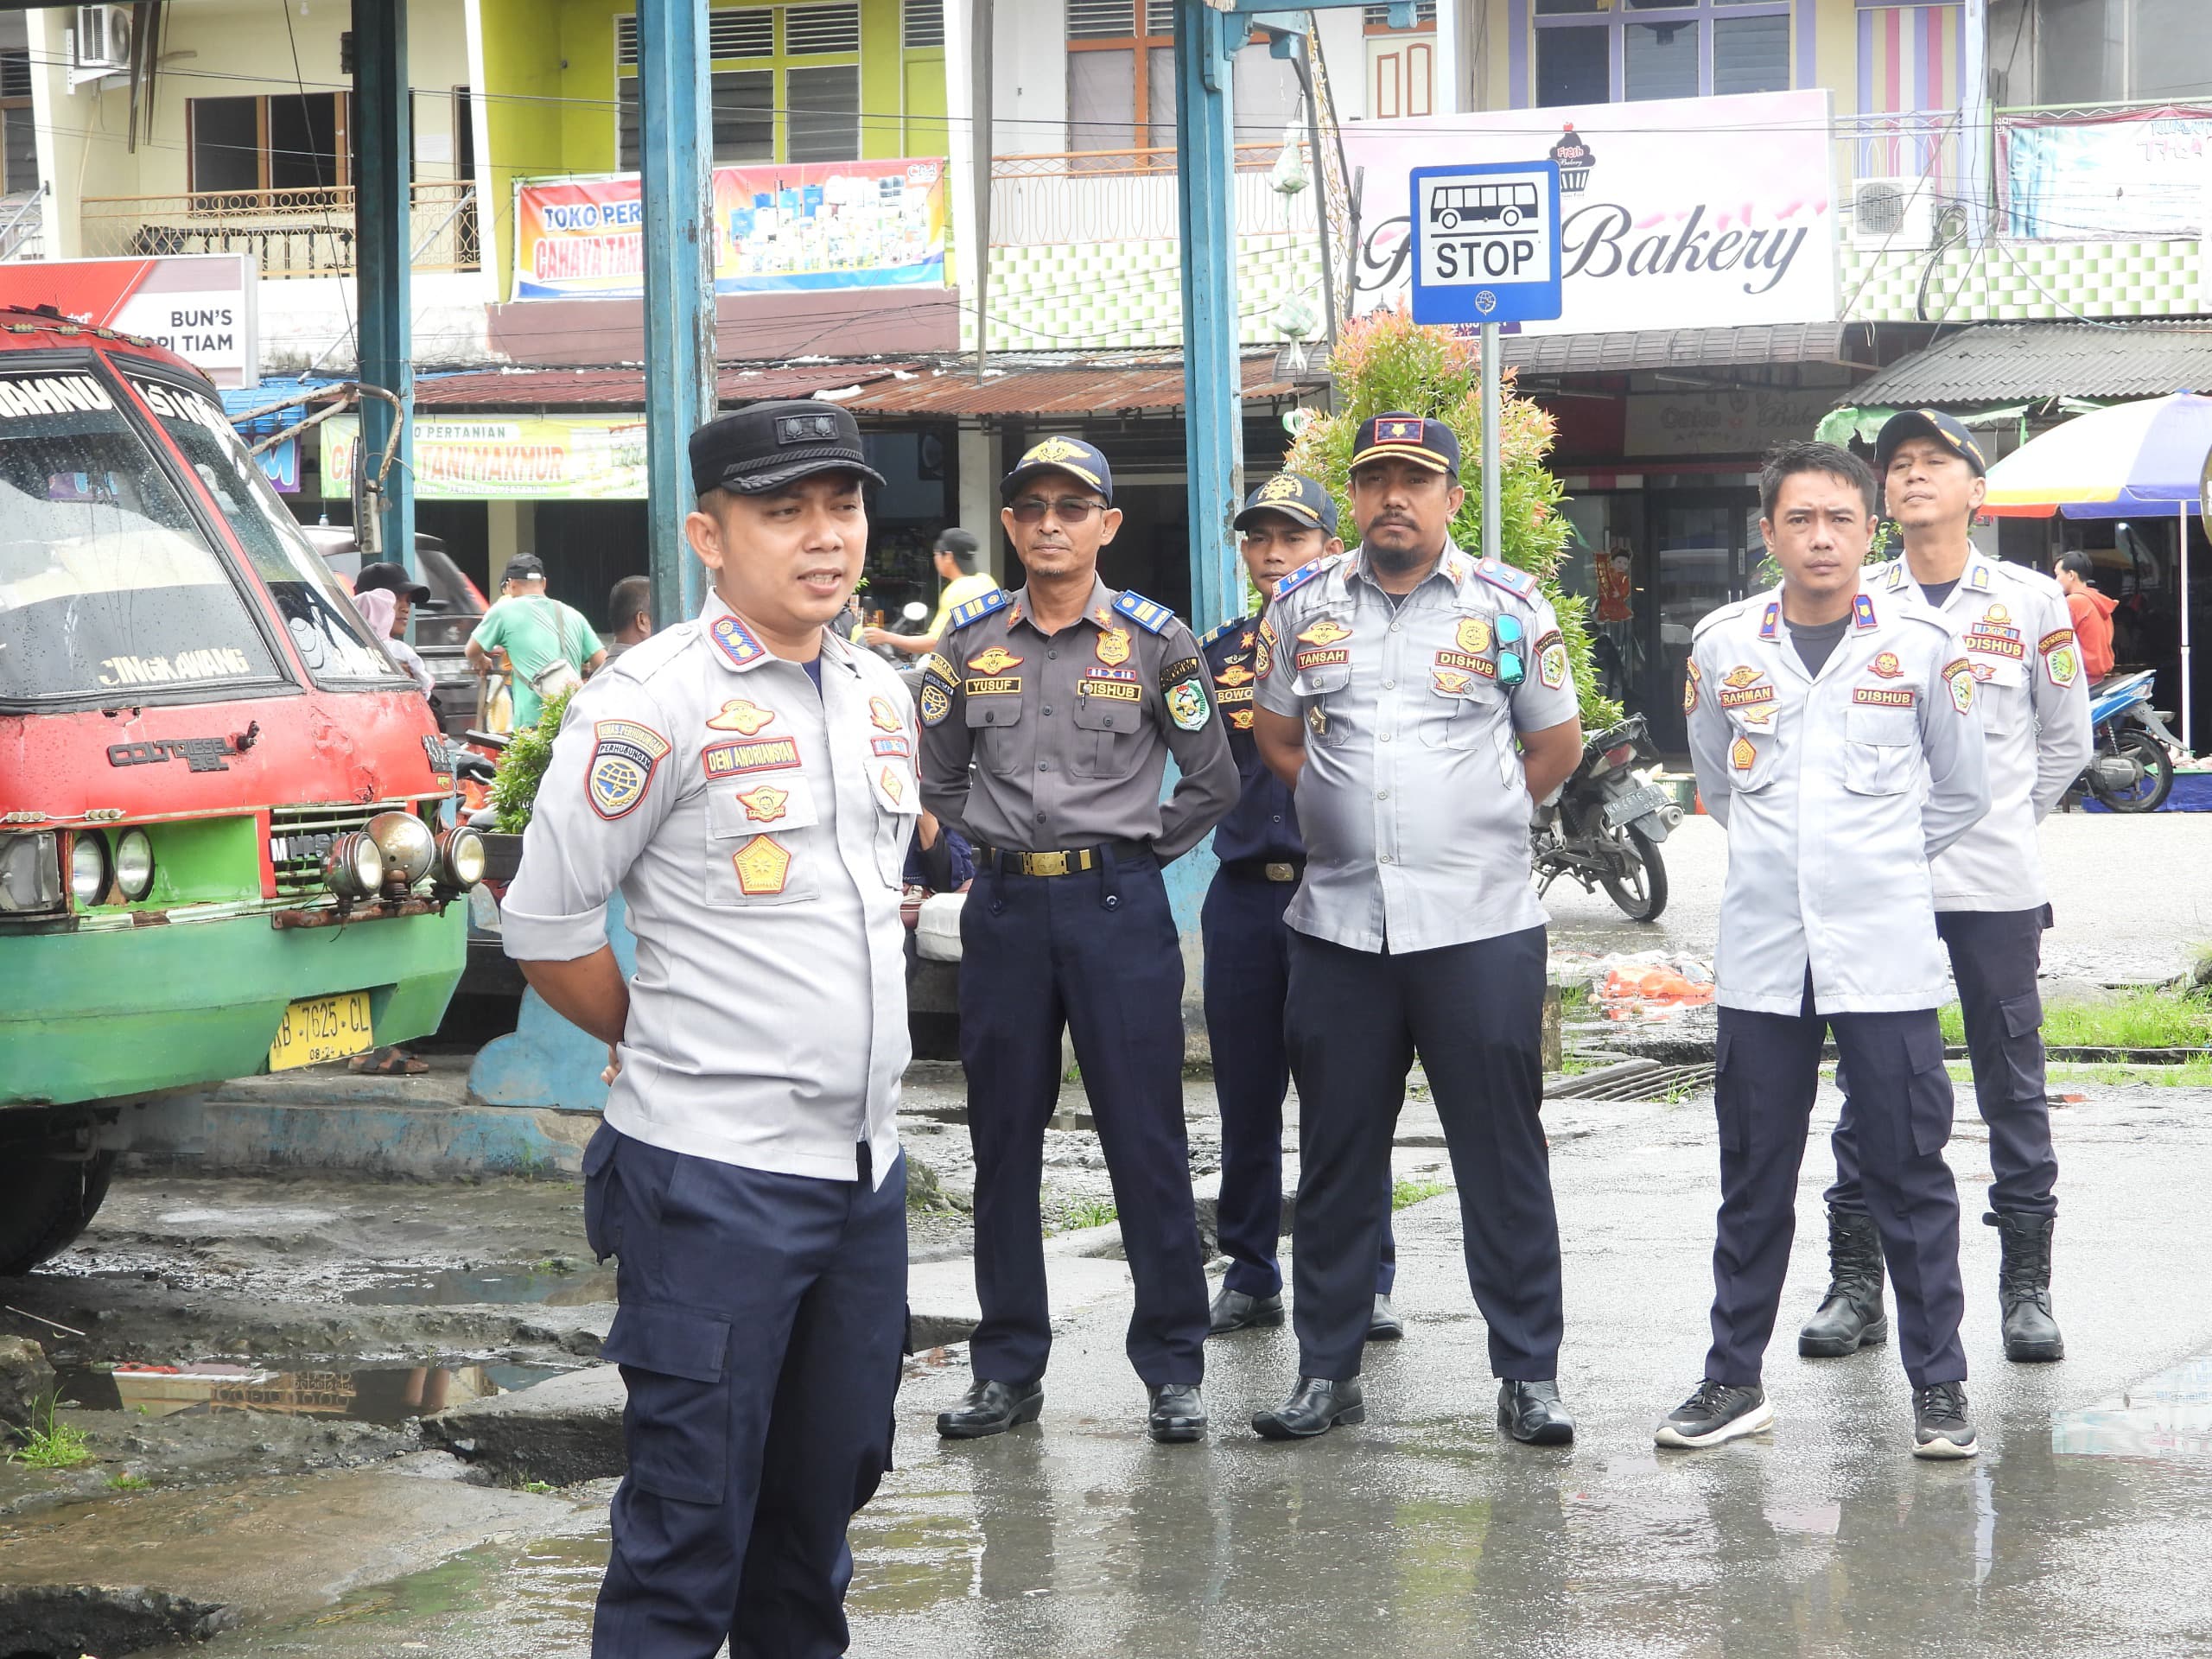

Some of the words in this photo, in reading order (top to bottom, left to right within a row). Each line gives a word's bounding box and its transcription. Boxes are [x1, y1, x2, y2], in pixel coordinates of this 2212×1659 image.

[1558, 146, 1584, 158] Fresh
[544, 205, 597, 228] TOKO
[536, 237, 602, 280] CAHAYA
[1436, 239, 1534, 278] STOP
[1561, 204, 1808, 294] Bakery
[171, 309, 232, 327] BUN'S
[181, 334, 232, 352] TIAM
[428, 426, 505, 439] PERTANIAN
[421, 446, 467, 481] TANI
[471, 445, 564, 481] MAKMUR
[1965, 638, 2022, 656] DISHUB
[1300, 651, 1344, 665] YANSAH
[1440, 653, 1494, 675] DISHUB
[973, 680, 1013, 691] YUSUF
[1217, 689, 1253, 702] BOWO
[1723, 687, 1770, 704] RAHMAN
[1857, 690, 1911, 705] DISHUB
[105, 740, 173, 767] COLT
[171, 737, 237, 759] DIESEL
[600, 744, 651, 769] PERHUBUNGAN
[708, 747, 734, 772] DENI
[302, 1001, 338, 1042] 7625
[349, 996, 369, 1032] CL
